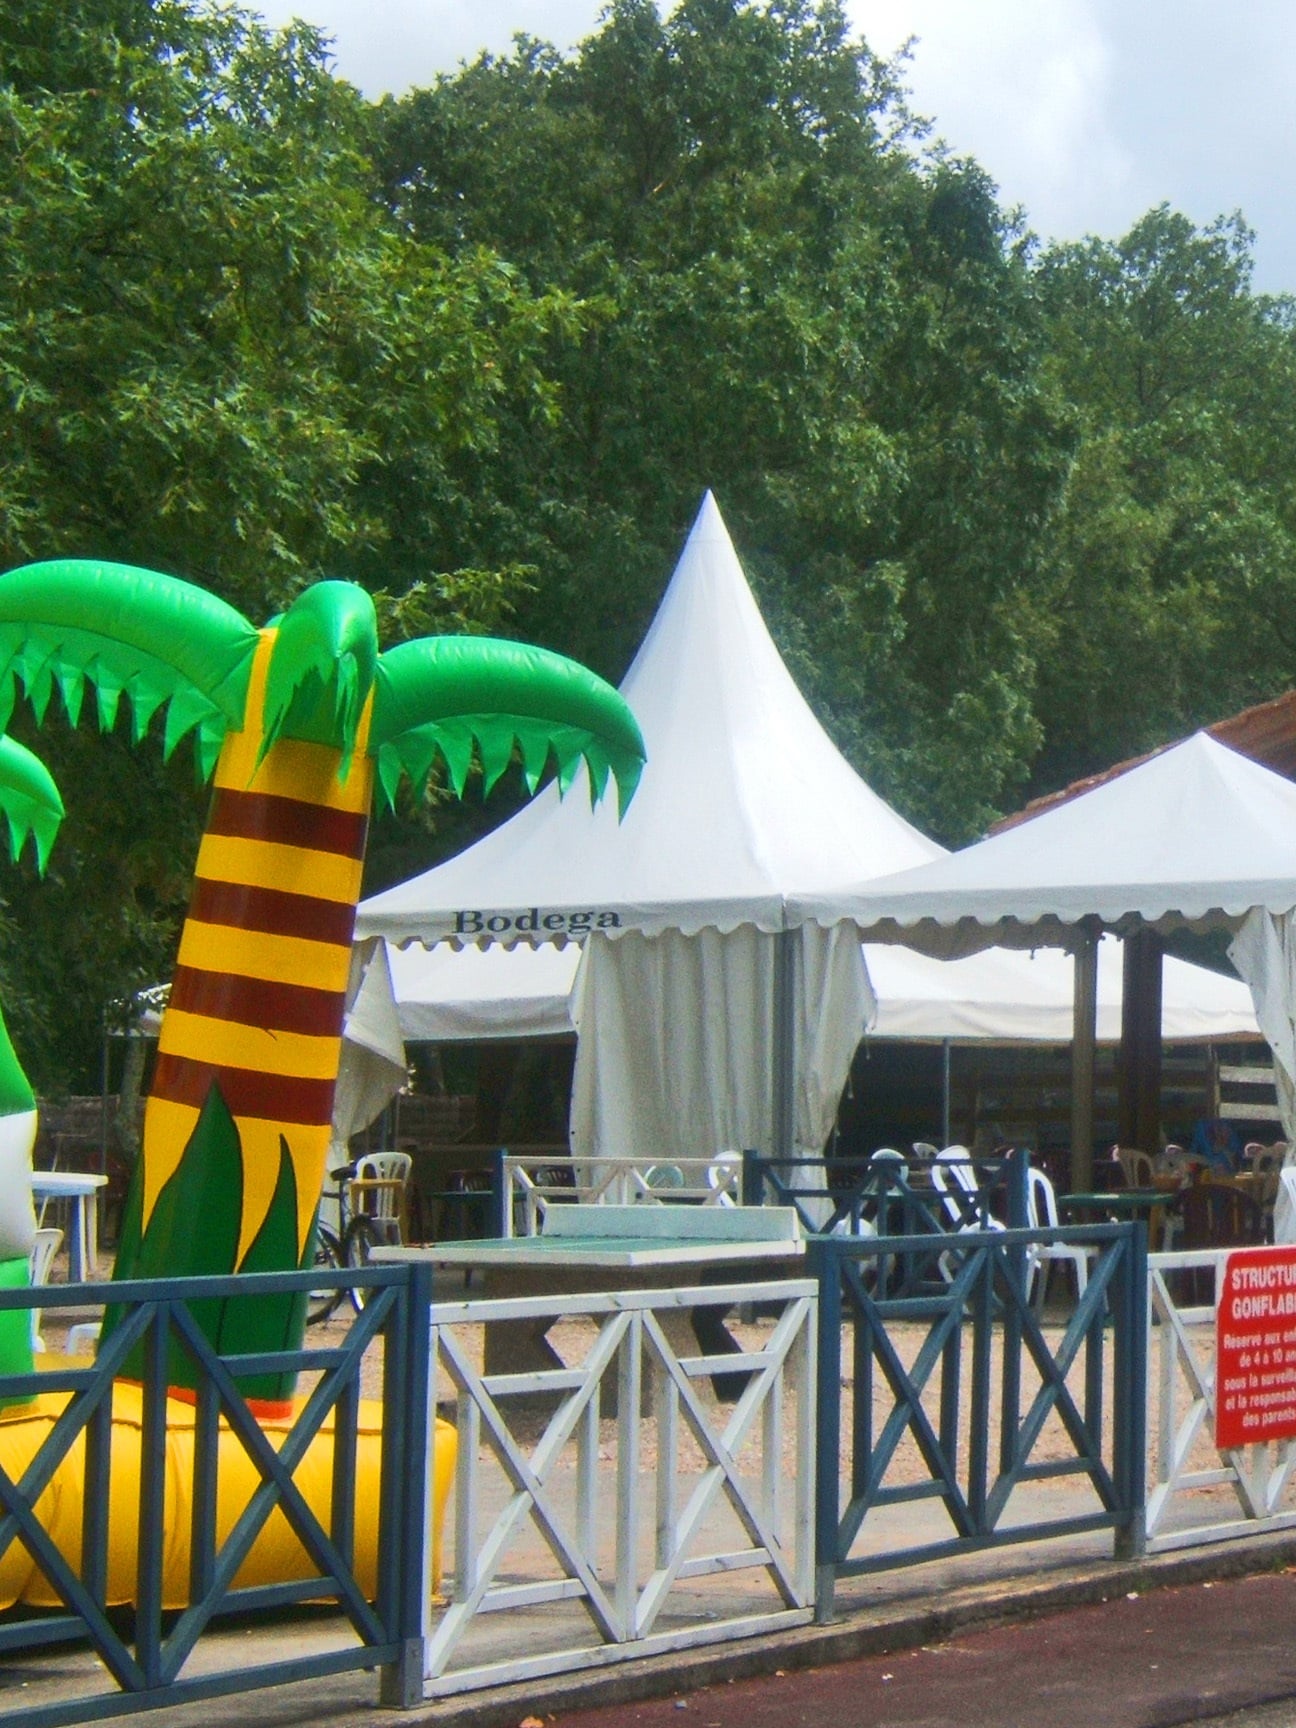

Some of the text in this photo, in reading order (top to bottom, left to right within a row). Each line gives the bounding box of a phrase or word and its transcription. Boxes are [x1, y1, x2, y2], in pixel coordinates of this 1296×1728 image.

[451, 907, 623, 935] Bodega
[1264, 1333, 1281, 1345] aux
[1239, 1352, 1252, 1368] de
[1254, 1351, 1261, 1365] 4
[1273, 1348, 1283, 1363] 10
[1223, 1377, 1247, 1391] sous
[1249, 1372, 1258, 1387] la
[1225, 1396, 1235, 1411] et
[1238, 1394, 1247, 1409] la
[1242, 1407, 1296, 1427] des parents
